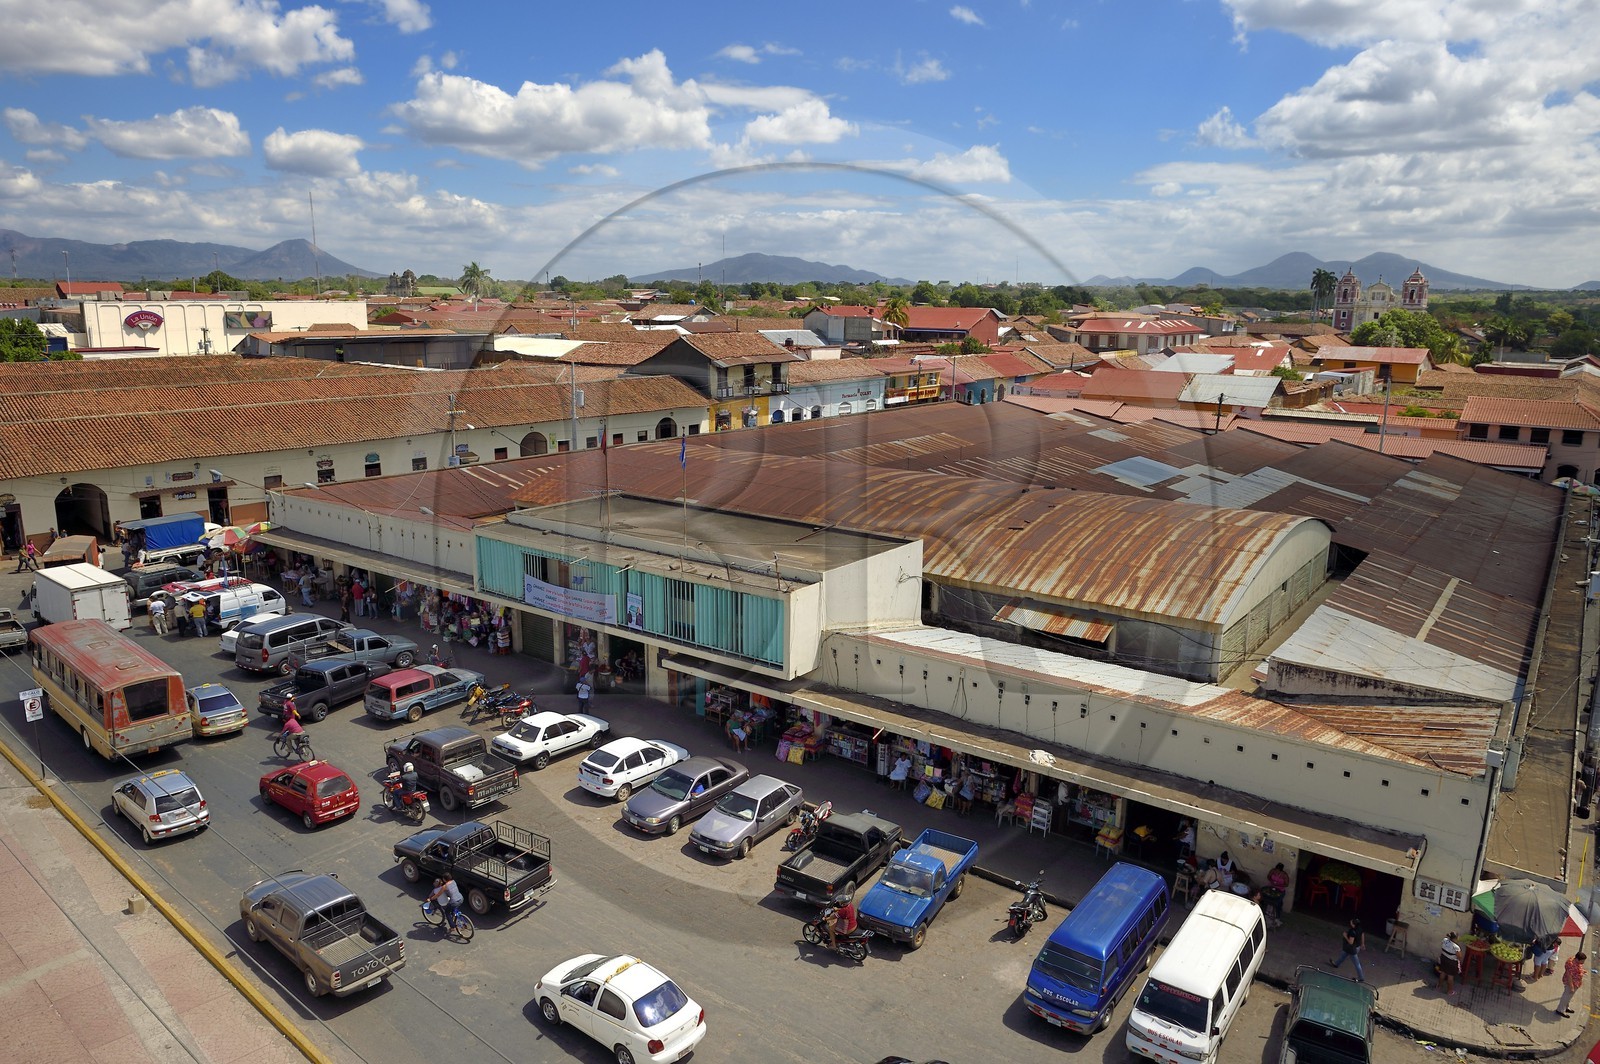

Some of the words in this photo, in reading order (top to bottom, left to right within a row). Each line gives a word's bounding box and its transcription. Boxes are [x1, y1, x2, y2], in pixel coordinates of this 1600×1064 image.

[139, 314, 158, 322] Unión
[351, 954, 391, 978] TOYOTA
[1055, 994, 1080, 1006] ESCOLAR
[1158, 1032, 1183, 1046] ESCOLAR
